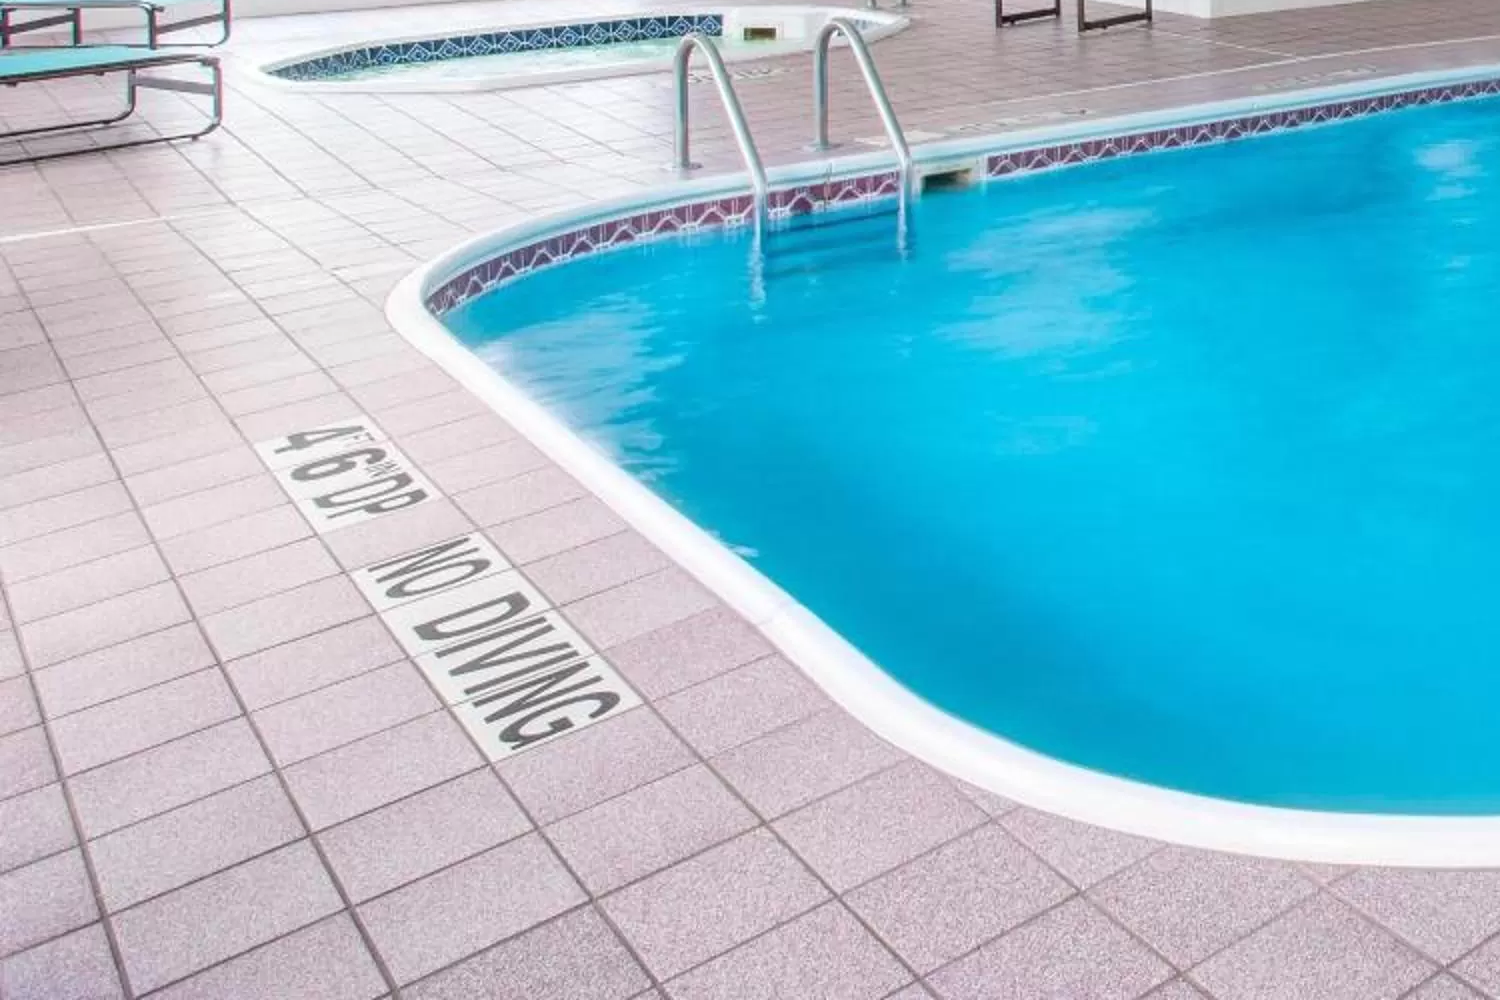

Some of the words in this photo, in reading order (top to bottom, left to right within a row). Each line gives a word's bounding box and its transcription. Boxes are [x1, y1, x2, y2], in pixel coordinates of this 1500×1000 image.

[313, 472, 429, 520] DP
[367, 537, 492, 599] NO
[412, 591, 622, 751] DIVING
